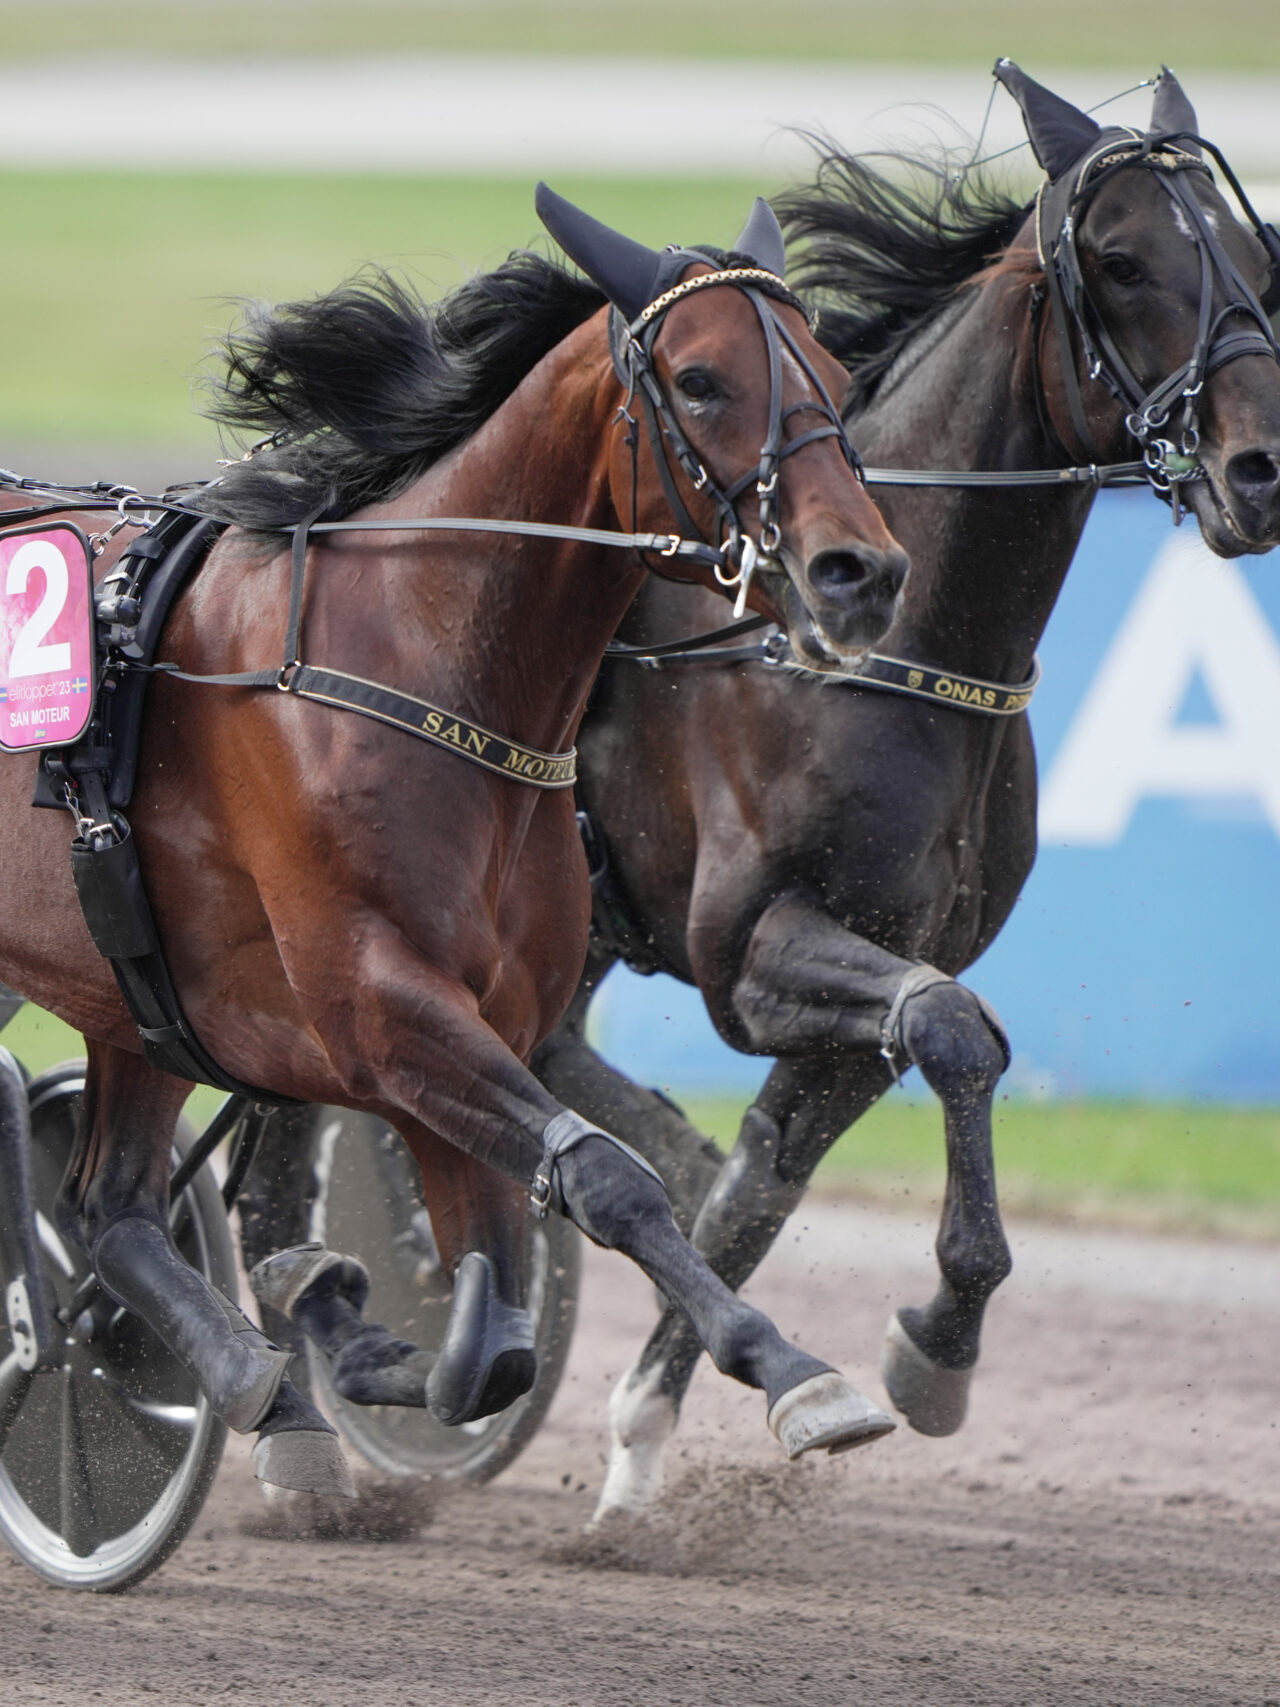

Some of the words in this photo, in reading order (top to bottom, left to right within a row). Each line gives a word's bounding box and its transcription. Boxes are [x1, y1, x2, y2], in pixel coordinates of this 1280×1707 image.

[5, 540, 71, 679] 2
[934, 677, 997, 706] ÖNAS
[10, 709, 30, 727] SAN
[31, 706, 70, 726] MOTEUR
[422, 712, 491, 755] SAN
